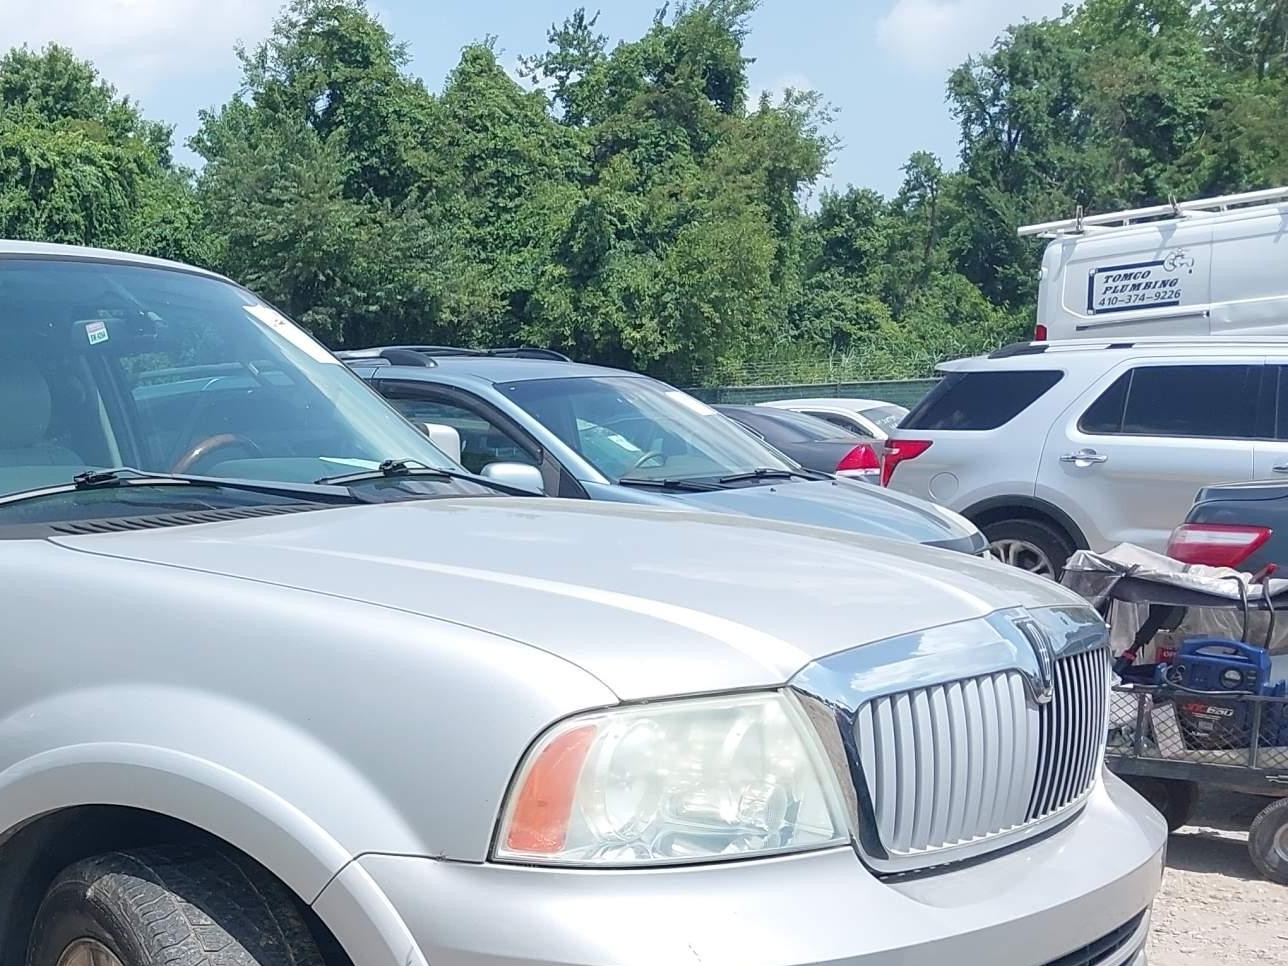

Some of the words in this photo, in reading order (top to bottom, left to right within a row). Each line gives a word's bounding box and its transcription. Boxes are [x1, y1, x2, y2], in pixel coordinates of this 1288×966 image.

[1103, 270, 1151, 284] TOMCO
[1102, 278, 1179, 295] PLUMBING
[1098, 289, 1182, 306] 410-374-9226
